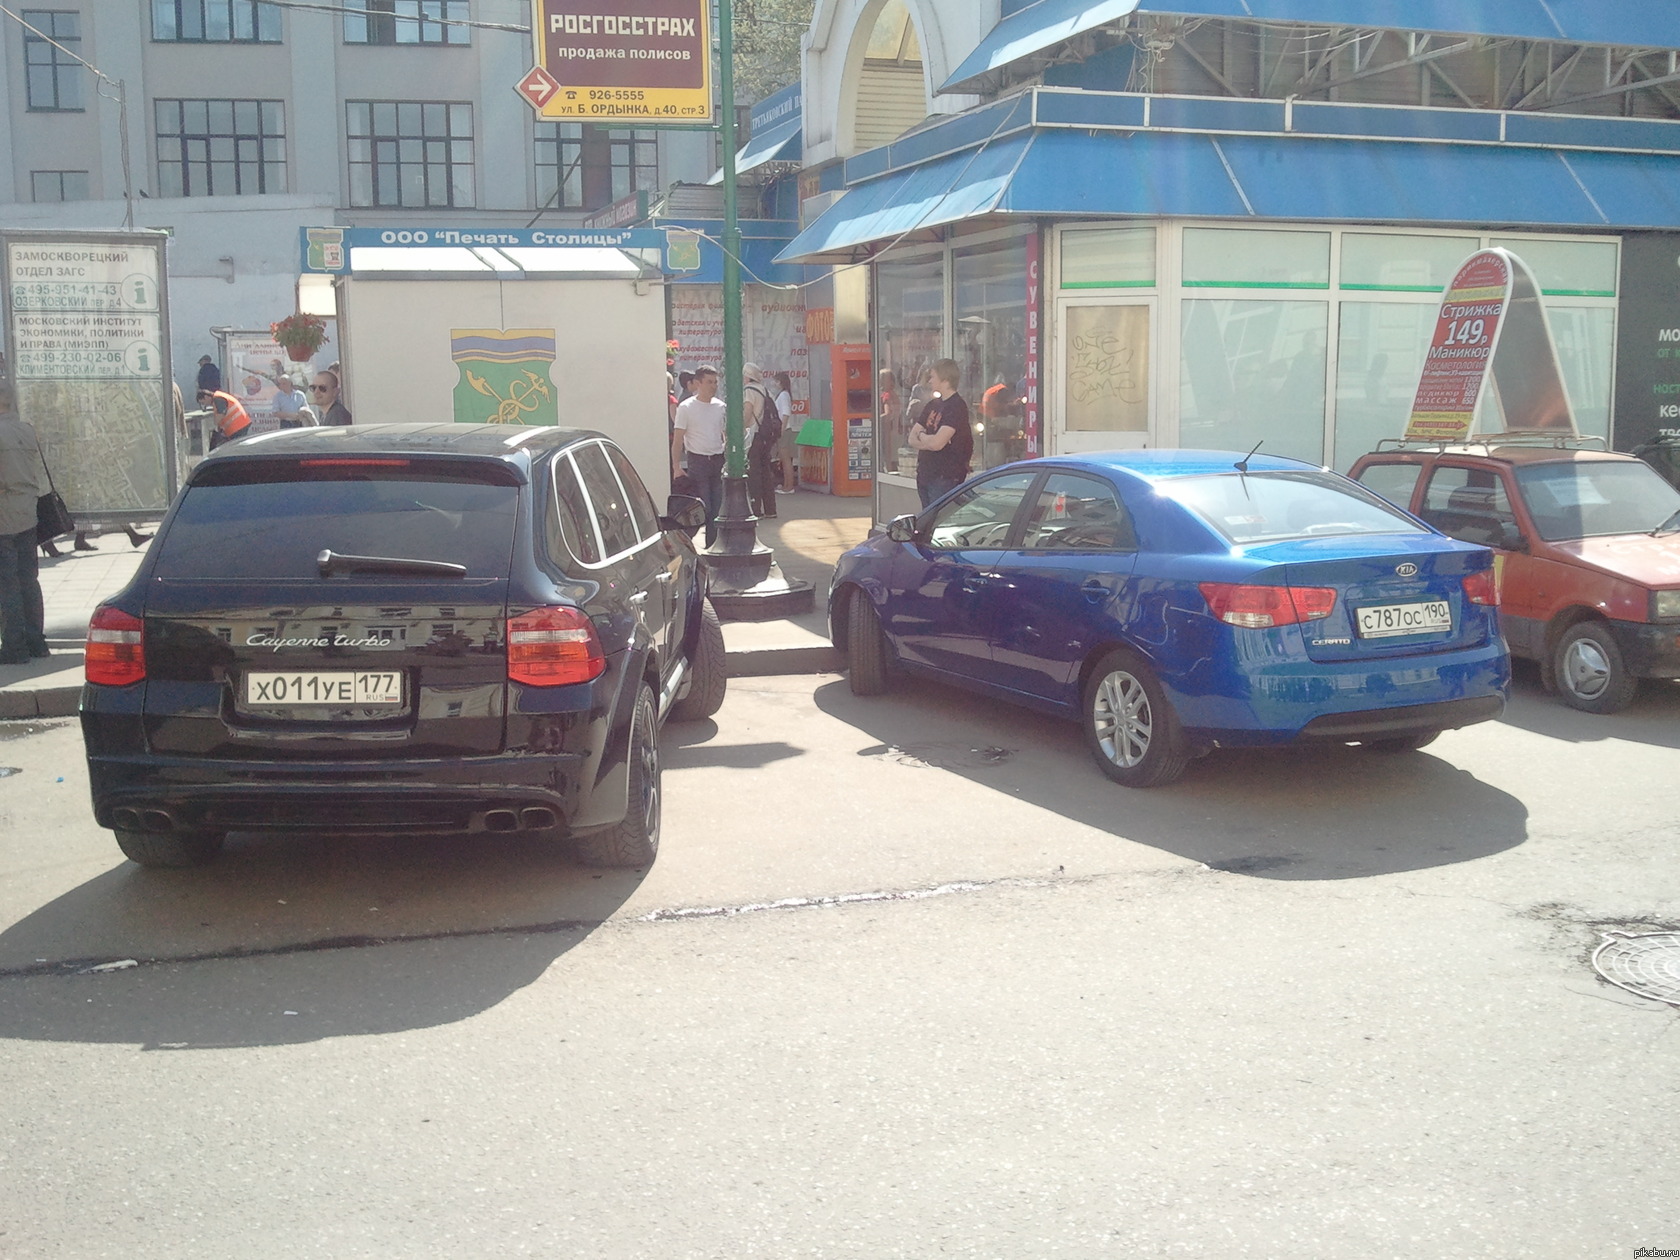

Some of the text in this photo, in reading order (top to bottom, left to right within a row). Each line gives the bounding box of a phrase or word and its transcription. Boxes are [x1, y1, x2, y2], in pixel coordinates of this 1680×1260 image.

[550, 14, 696, 37] РОСГОССТРАХ
[558, 47, 691, 61] продажа полисов
[589, 90, 644, 100] 926-5555
[381, 231, 429, 244] ООО
[15, 251, 129, 263] ЗАМОСКВОРЕЦКИЙ
[16, 266, 86, 278] ОТДЕЛ ЗАГС
[28, 284, 117, 296] 495-951-41-43
[15, 296, 88, 307] ОЗЕРКОВСКИЙ
[1441, 303, 1502, 320] Стрижка
[19, 317, 142, 326] МОСКОВСКИЙ ИНСТИТУТ
[20, 328, 145, 338] ЭКОНОМИКИ, ПОЛИТИКИ
[20, 340, 109, 350] И ПРАВА (МИЭПП)
[33, 352, 122, 363] 499-230-02-06
[1027, 260, 1038, 454] СУВЕНИРЫ
[1428, 346, 1491, 360] Маникюр
[20, 363, 96, 375] КЛИМЕНТОВСКИЙ
[1399, 566, 1415, 574] KIA
[1424, 603, 1446, 619] 190
[246, 633, 391, 653] Cayenne turbo
[1311, 638, 1351, 646] CERATO
[358, 674, 394, 693] 177
[365, 693, 385, 701] RUS
